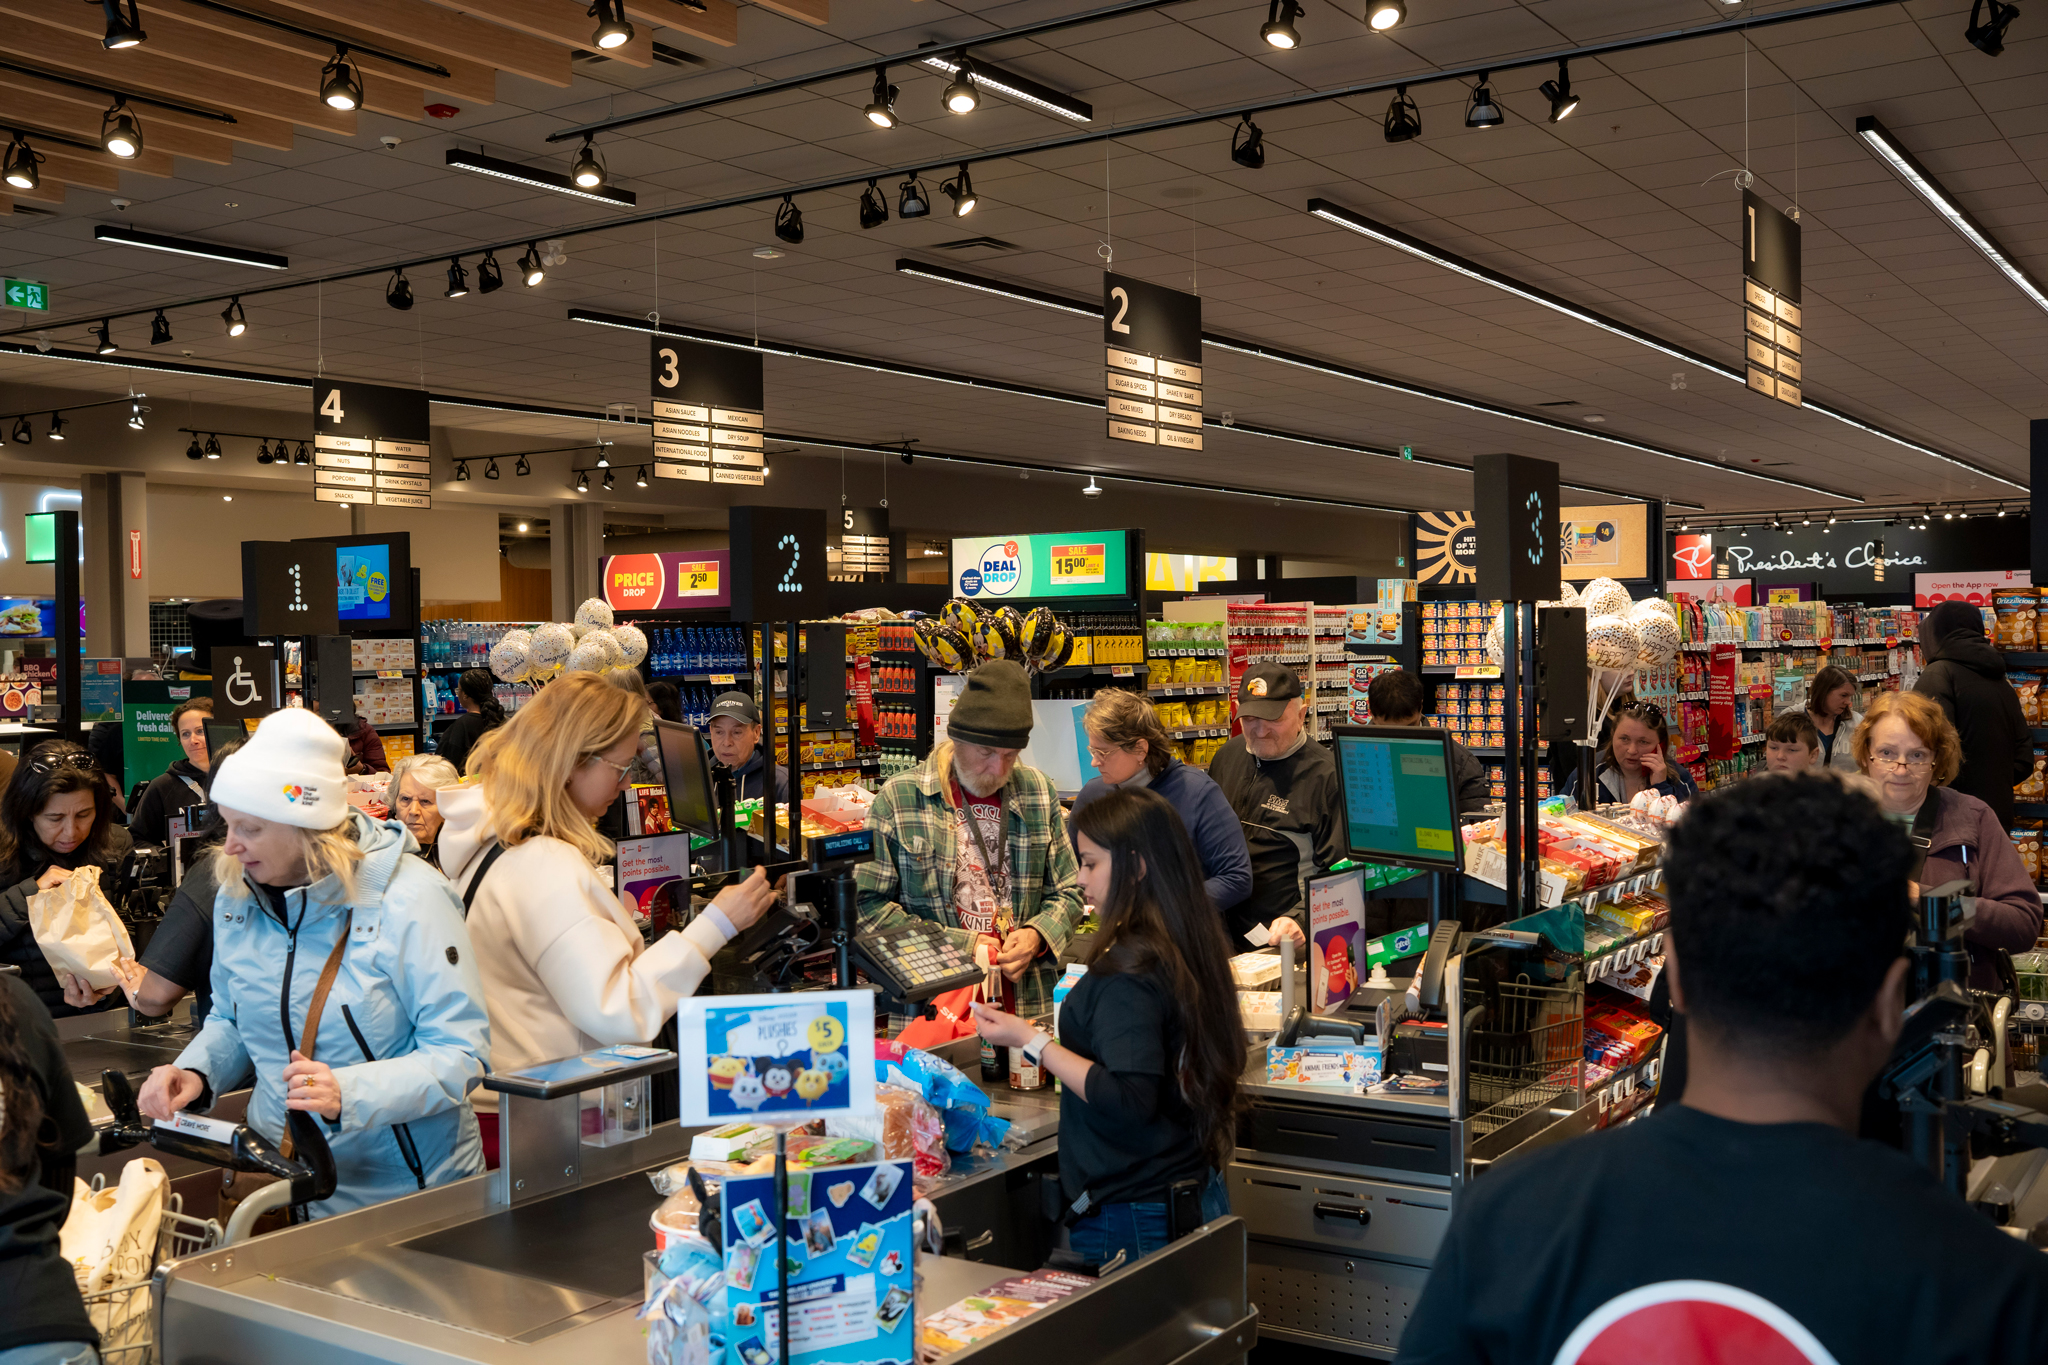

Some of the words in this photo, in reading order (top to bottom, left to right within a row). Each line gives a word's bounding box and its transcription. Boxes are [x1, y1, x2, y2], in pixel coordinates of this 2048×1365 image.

[1748, 206, 1756, 262] 1
[1111, 286, 1130, 334] 2
[1124, 357, 1138, 366] FLOUR
[658, 348, 679, 388] 3
[1174, 368, 1186, 376] SPICES
[1116, 379, 1129, 388] SUGAR
[1134, 383, 1147, 391] SPICES
[1166, 389, 1180, 398] SHAKE
[1184, 392, 1194, 400] BAKE
[320, 389, 344, 423] 4
[1120, 404, 1130, 412] CAKE
[1131, 405, 1143, 414] MIXES
[1177, 412, 1192, 421] BREADS
[677, 428, 700, 436] NOODLES
[1118, 426, 1132, 436] BAKING
[1133, 429, 1146, 438] NEEDS
[1177, 436, 1194, 445] VINEGAR
[656, 447, 693, 456] INTERNATIONAL
[844, 510, 854, 529] 5
[1526, 491, 1543, 565] 3
[1601, 527, 1610, 537] $4
[1068, 546, 1087, 555] SALE
[778, 534, 802, 592] 2
[1728, 546, 1837, 574] President's
[984, 561, 1016, 572] DEAL
[371, 577, 384, 586] FREE
[614, 572, 654, 587] PRICE
[984, 572, 1016, 583] DROP
[288, 564, 308, 611] 1
[623, 588, 645, 597] DROP
[1642, 639, 1671, 656] HAPPY
[1596, 649, 1627, 659] HAPPY
[495, 654, 525, 677] Congrats!
[137, 722, 157, 731] fresh
[826, 839, 852, 850] INITIALIZING
[648, 856, 663, 864] most
[1472, 847, 1484, 874] ROCHER
[622, 868, 642, 879] points
[644, 865, 671, 876] possible.
[1312, 902, 1322, 913] Get
[1332, 897, 1344, 907] most
[1312, 913, 1328, 926] points
[1329, 909, 1350, 921] possible.
[1600, 910, 1626, 923] HALLS
[940, 1006, 958, 1023] SH
[758, 1021, 798, 1039] PLUSHIES
[816, 1022, 832, 1038] $5
[1322, 1063, 1340, 1071] FRIENDS
[181, 1119, 196, 1129] CRAVE
[196, 1123, 211, 1132] MORE
